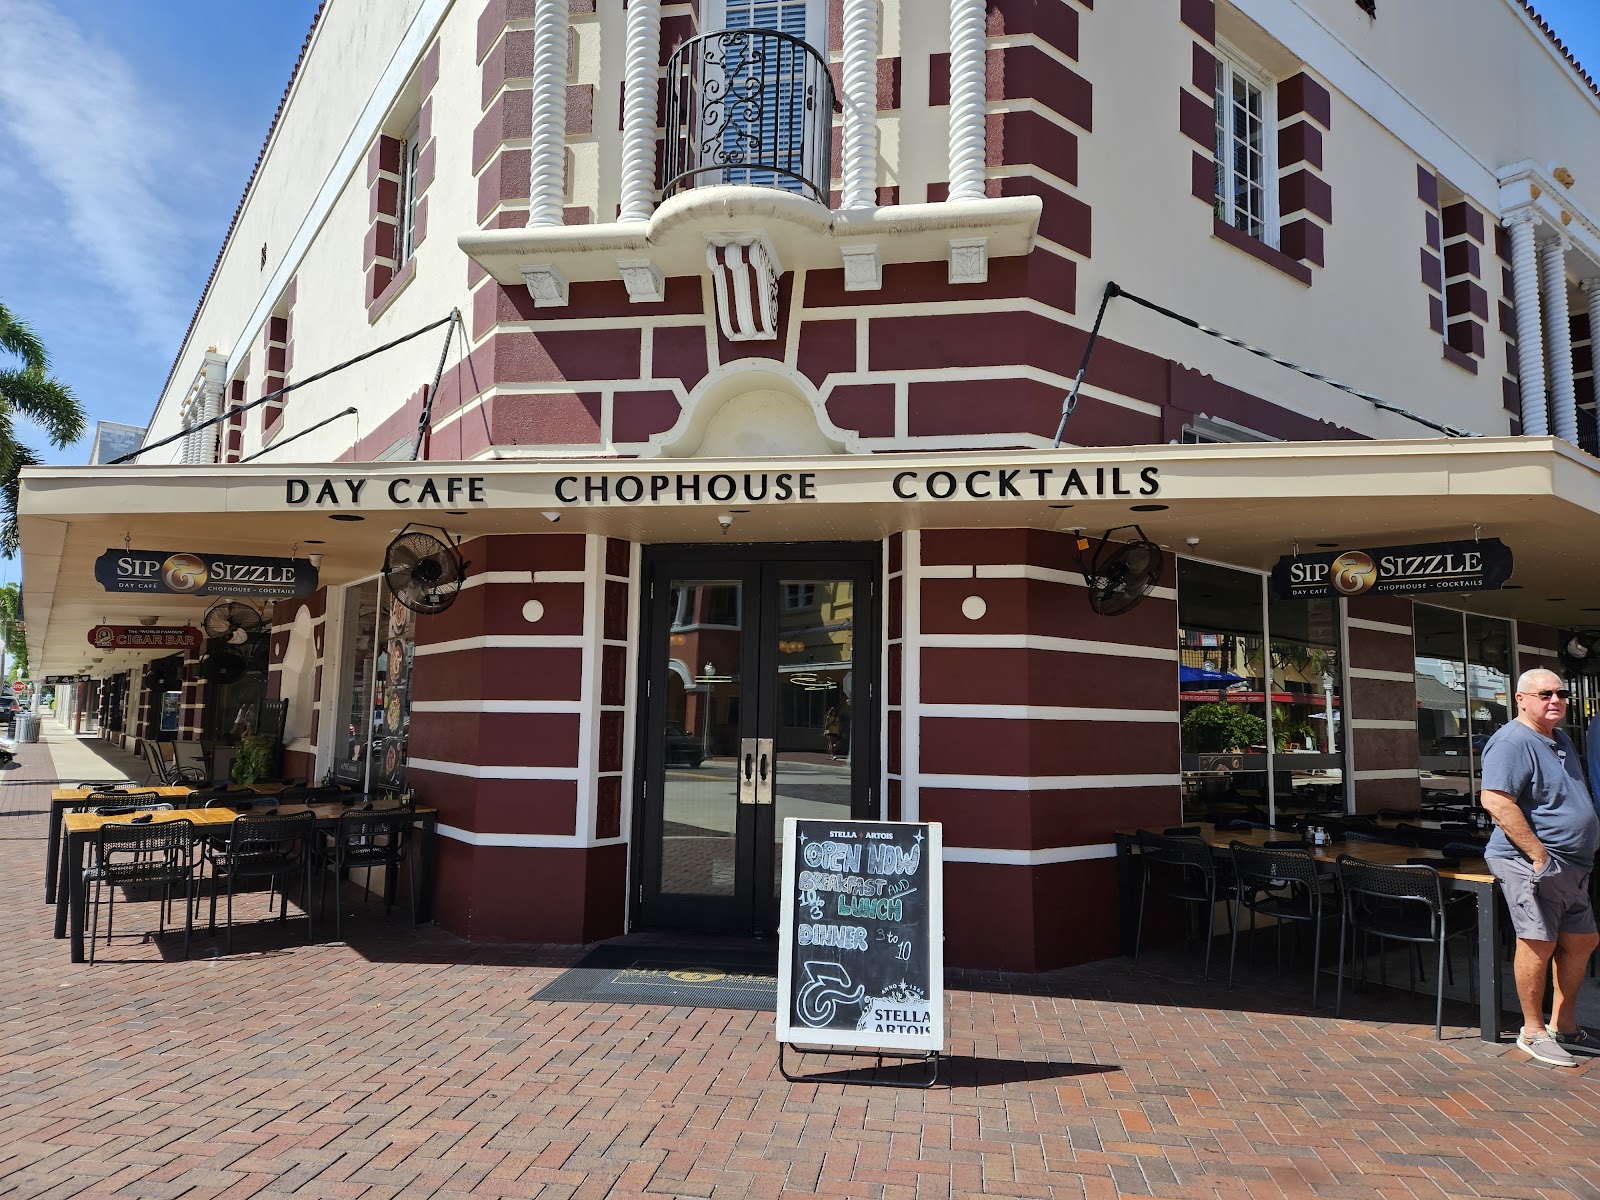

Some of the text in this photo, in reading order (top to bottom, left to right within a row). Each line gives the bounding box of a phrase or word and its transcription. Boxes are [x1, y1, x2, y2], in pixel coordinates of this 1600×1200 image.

[286, 466, 1159, 504] DAY CAFE CHOPHOUSE COCKTAILS
[116, 557, 296, 590] SIP & SIZZLE
[1290, 552, 1483, 593] SIP & SIZZLE
[258, 587, 295, 595] COCKTAILS
[1378, 583, 1427, 591] CHOPHOUSE
[1436, 580, 1483, 588] COCKTAILS
[116, 634, 163, 645] CIGAR
[165, 635, 195, 646] BAR
[829, 831, 894, 840] STELLA ARTOIS
[804, 840, 921, 876] OPEN NOW
[798, 870, 910, 897] BREAKFAST AND
[798, 889, 817, 907] 10
[809, 906, 824, 920] 3
[838, 894, 903, 922] LUNCH
[798, 923, 899, 952] DINNER 3 to
[895, 941, 912, 961] 10
[881, 983, 925, 996] ANNO 1366
[874, 1008, 931, 1023] STELLA
